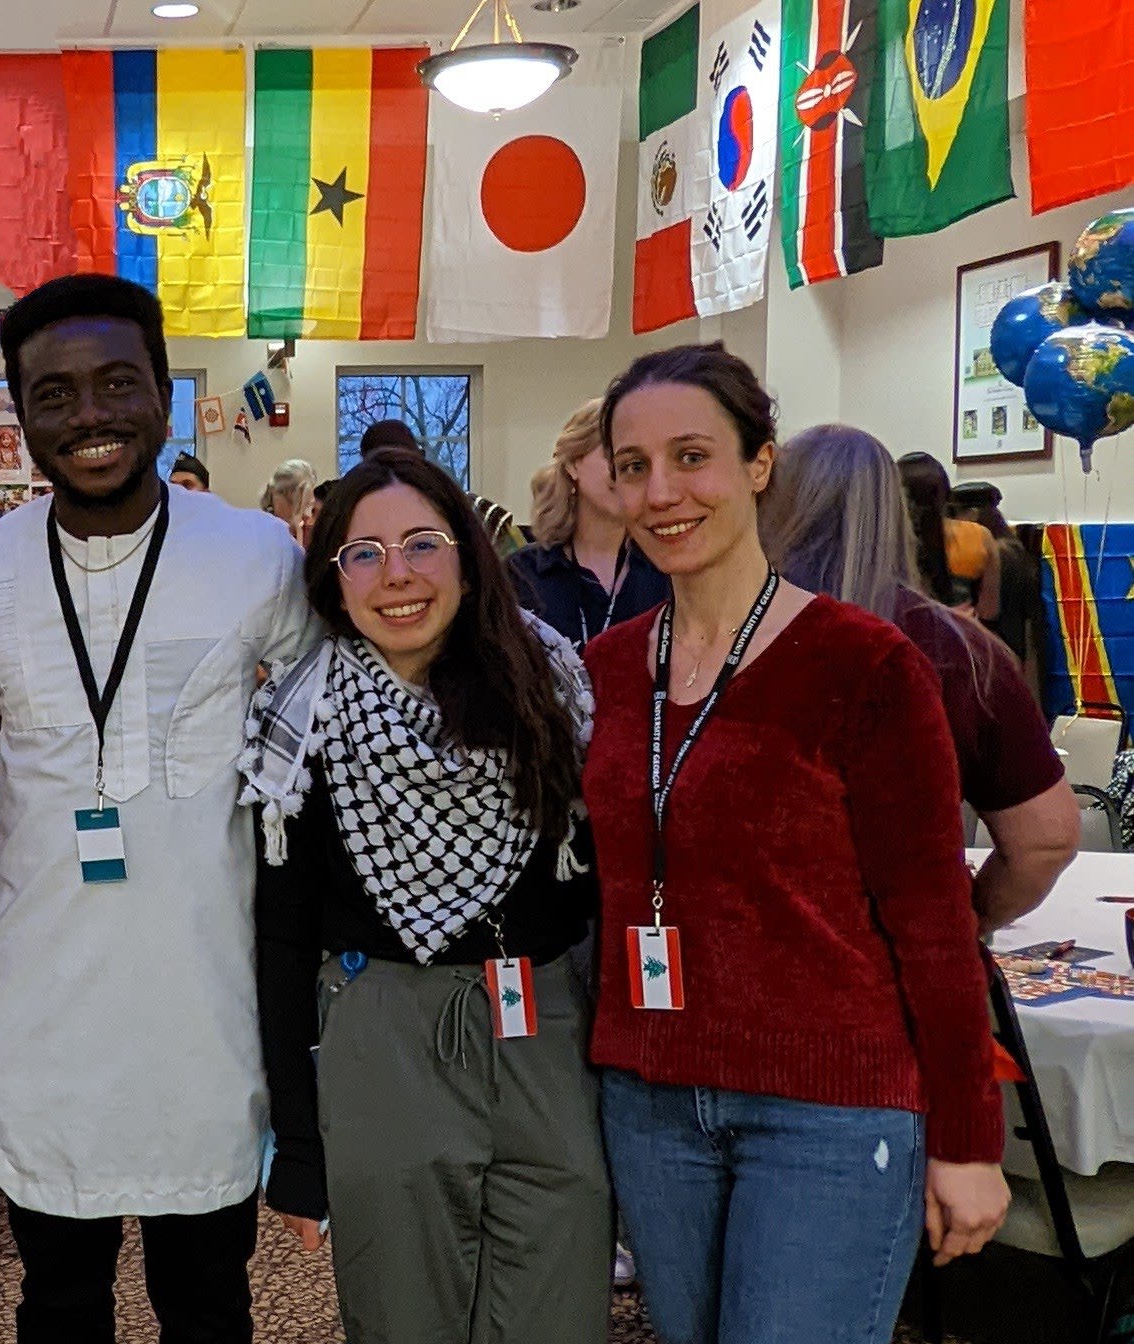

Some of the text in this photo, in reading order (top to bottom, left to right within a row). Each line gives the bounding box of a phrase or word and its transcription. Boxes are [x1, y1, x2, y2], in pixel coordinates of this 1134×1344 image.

[733, 575, 777, 655] UNIVERSITY OF GEORGIA
[701, 691, 718, 716] Campus
[653, 742, 660, 753] OF
